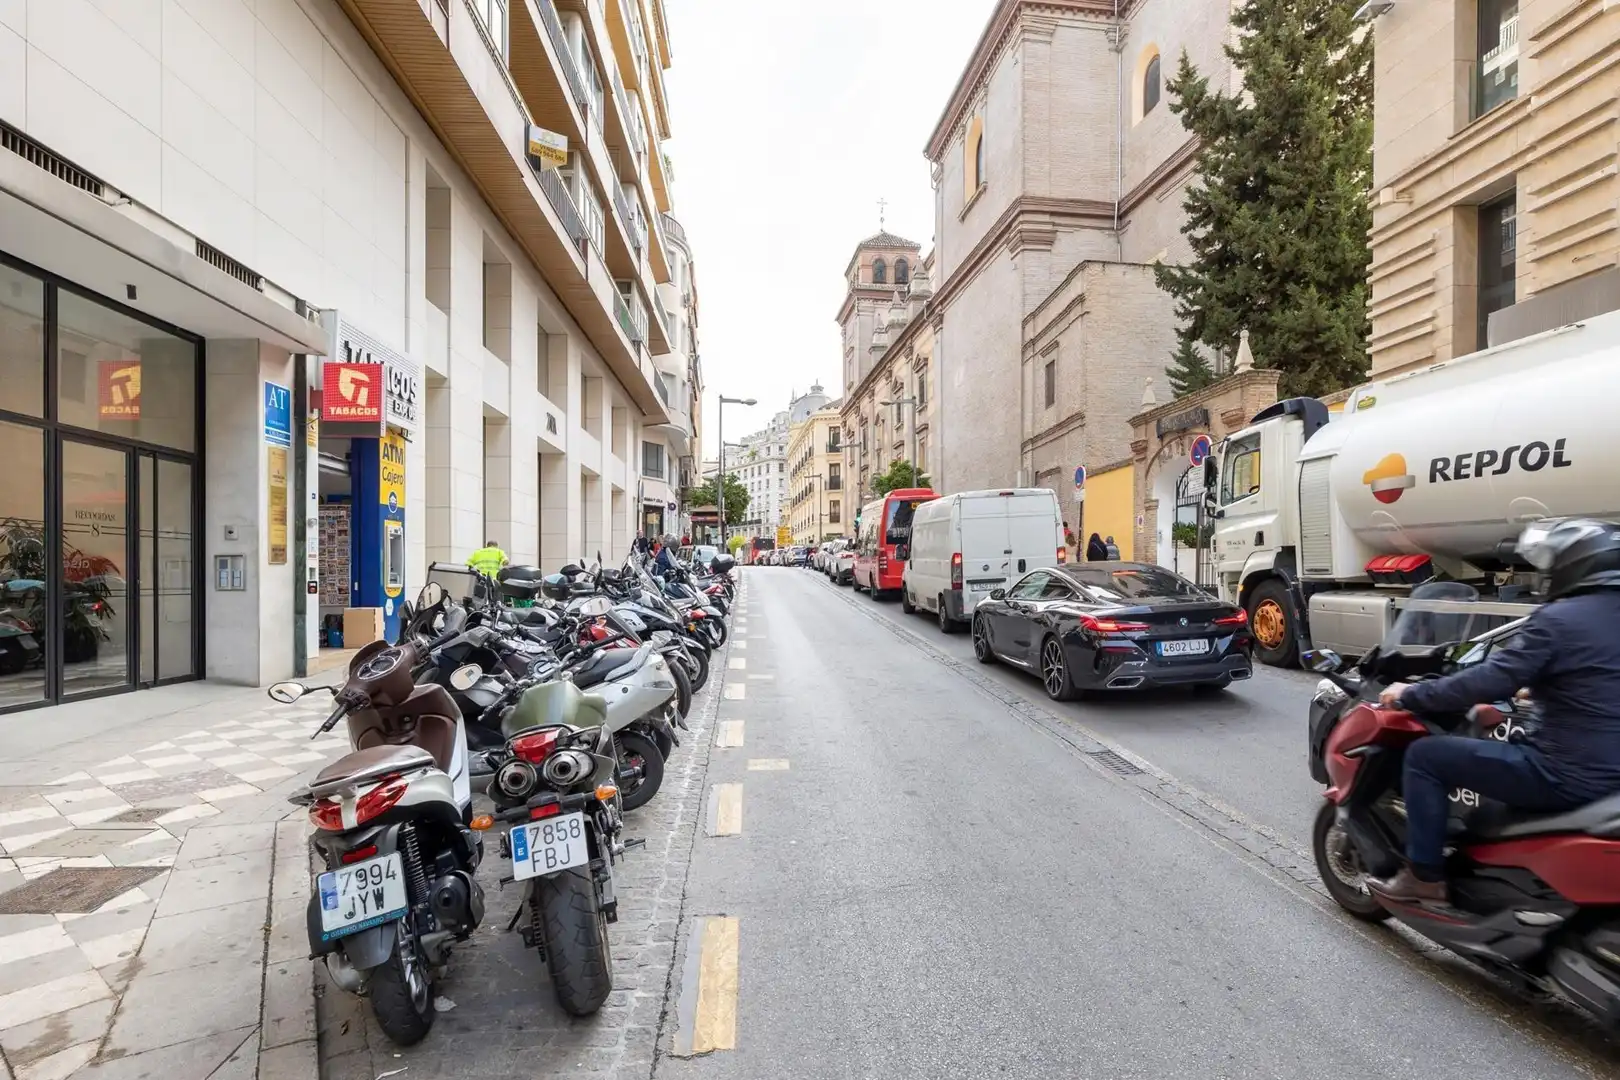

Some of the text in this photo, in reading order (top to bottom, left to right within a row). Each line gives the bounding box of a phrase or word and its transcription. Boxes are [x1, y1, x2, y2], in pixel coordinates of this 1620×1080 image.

[268, 387, 287, 410] AT
[329, 406, 378, 415] TABACOS
[382, 442, 404, 465] ATM
[1429, 438, 1572, 483] REPSOL
[382, 466, 404, 486] Cajero
[91, 523, 100, 537] 8
[1163, 641, 1206, 652] 4602 LJJ
[529, 818, 581, 849] 7858
[517, 847, 525, 856] E
[531, 843, 571, 873] FBJ
[339, 860, 397, 896] 7994
[344, 886, 385, 919] JYW
